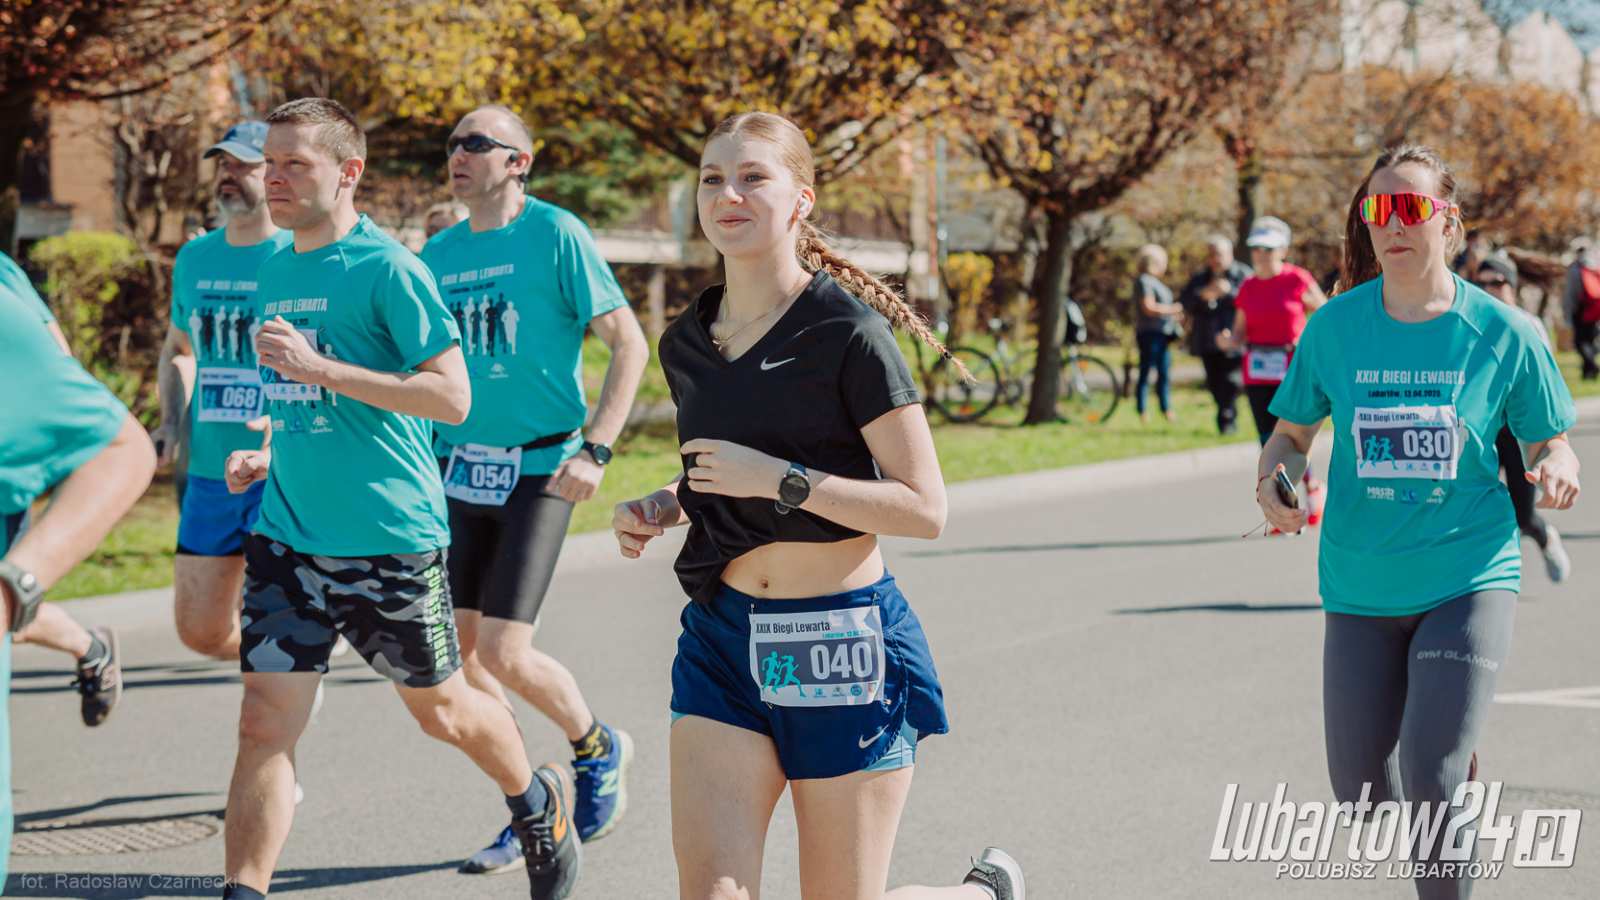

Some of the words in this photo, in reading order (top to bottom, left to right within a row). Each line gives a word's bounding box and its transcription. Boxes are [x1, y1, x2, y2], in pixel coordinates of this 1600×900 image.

[1355, 369, 1380, 384] XXIX
[1382, 370, 1411, 385] BIEGI
[1414, 370, 1466, 385] LEWARTA
[221, 386, 258, 409] 068
[1402, 429, 1451, 458] 030
[471, 464, 512, 489] 054
[756, 623, 771, 634] XXIX
[773, 622, 794, 635] Biegi
[795, 621, 831, 633] Lewarta
[809, 641, 873, 680] 040
